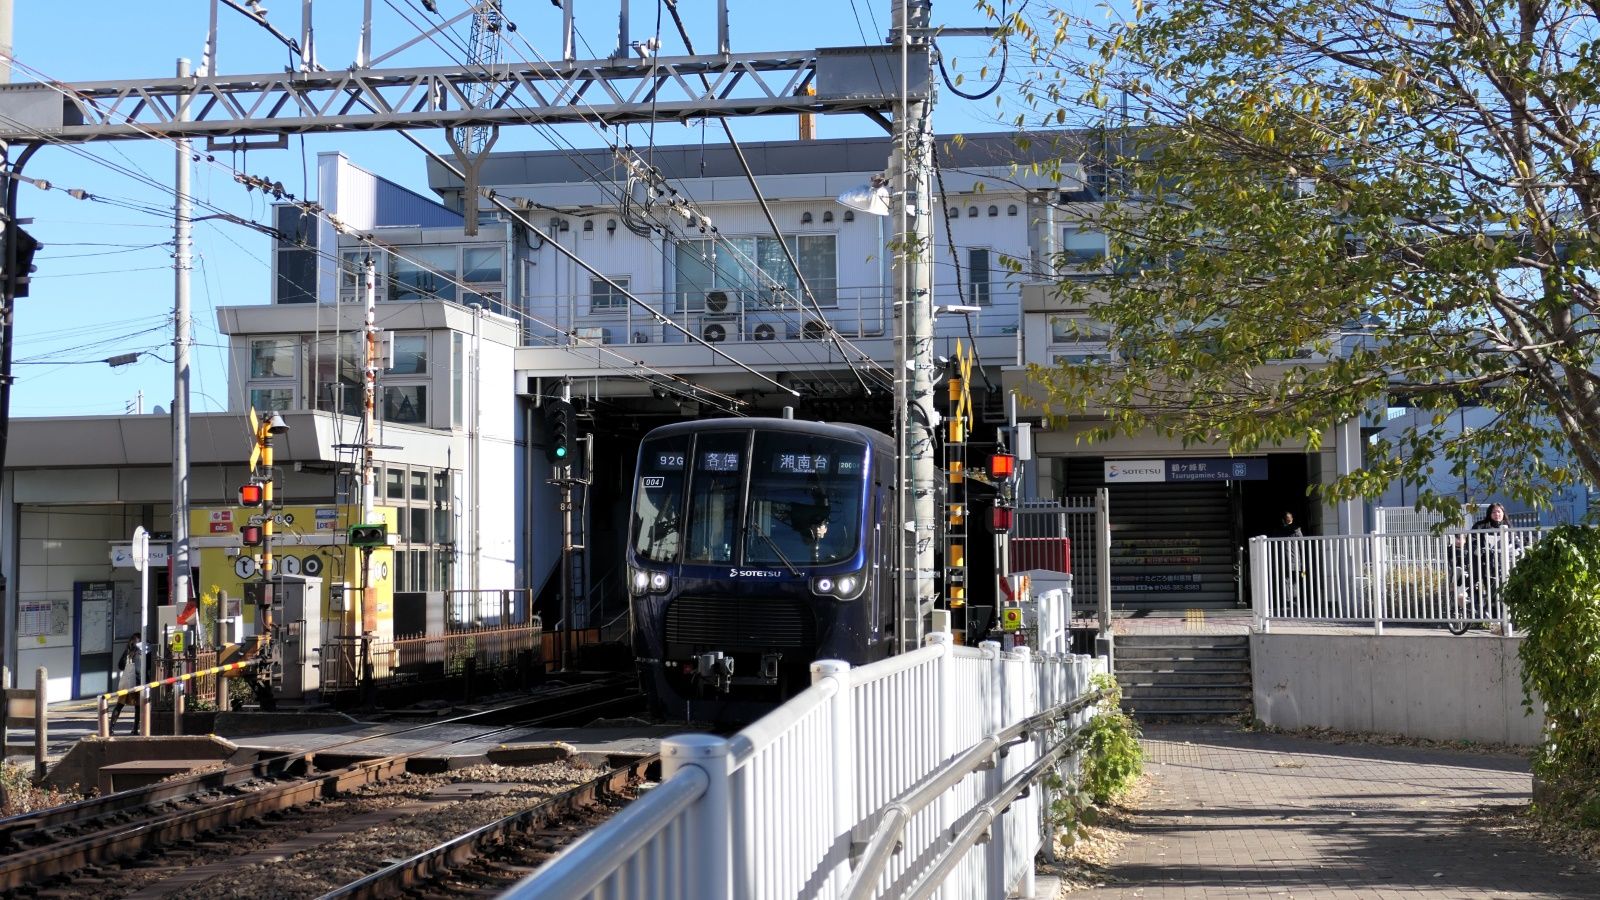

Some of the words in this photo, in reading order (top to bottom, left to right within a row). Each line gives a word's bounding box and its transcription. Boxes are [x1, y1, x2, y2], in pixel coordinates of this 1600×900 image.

[660, 456, 684, 466] 92G
[707, 453, 737, 467] 各停
[780, 453, 828, 469] 湘南台
[645, 478, 660, 486] 004
